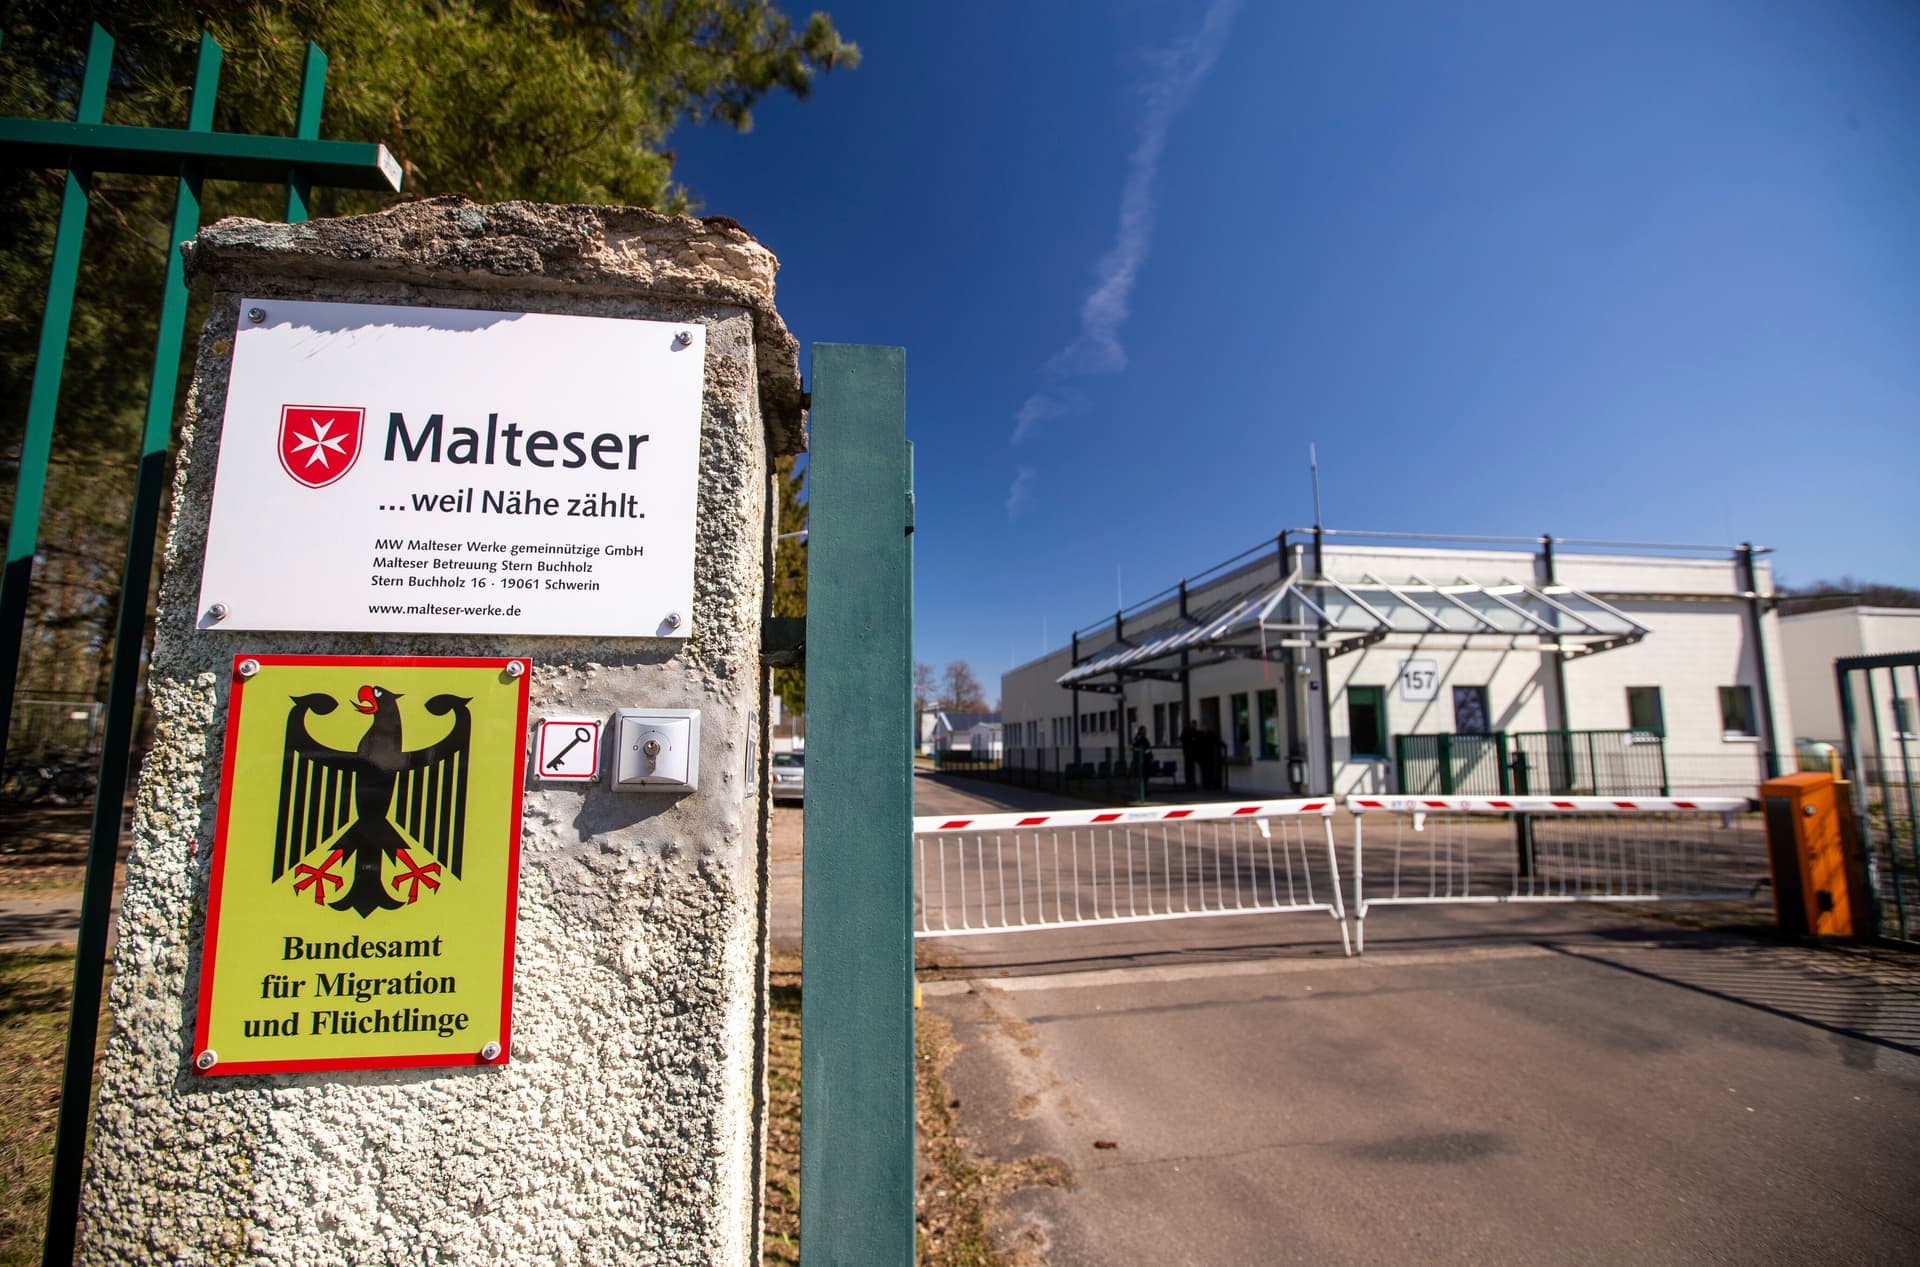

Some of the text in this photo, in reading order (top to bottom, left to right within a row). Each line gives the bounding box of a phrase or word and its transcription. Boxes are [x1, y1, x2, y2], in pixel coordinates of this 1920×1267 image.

[384, 412, 649, 470] Malteser
[482, 490, 559, 515] Nähe
[567, 492, 644, 518] zählt.
[375, 539, 643, 558] MW Malteser Werke gemeinnützige GmbH
[373, 557, 592, 573] Malteser Betreuung Stern Buchholz
[371, 575, 403, 586] Stern
[409, 576, 465, 587] Buchholz
[471, 578, 486, 588] 16
[501, 578, 538, 589] 19061
[545, 579, 599, 590] Schwerin
[369, 603, 521, 616] www.malteser-werke.de
[1404, 671, 1434, 689] 157
[281, 935, 443, 960] Bundesamt
[261, 971, 456, 1003] für Migration
[243, 1008, 469, 1038] und Flüchtlinge
